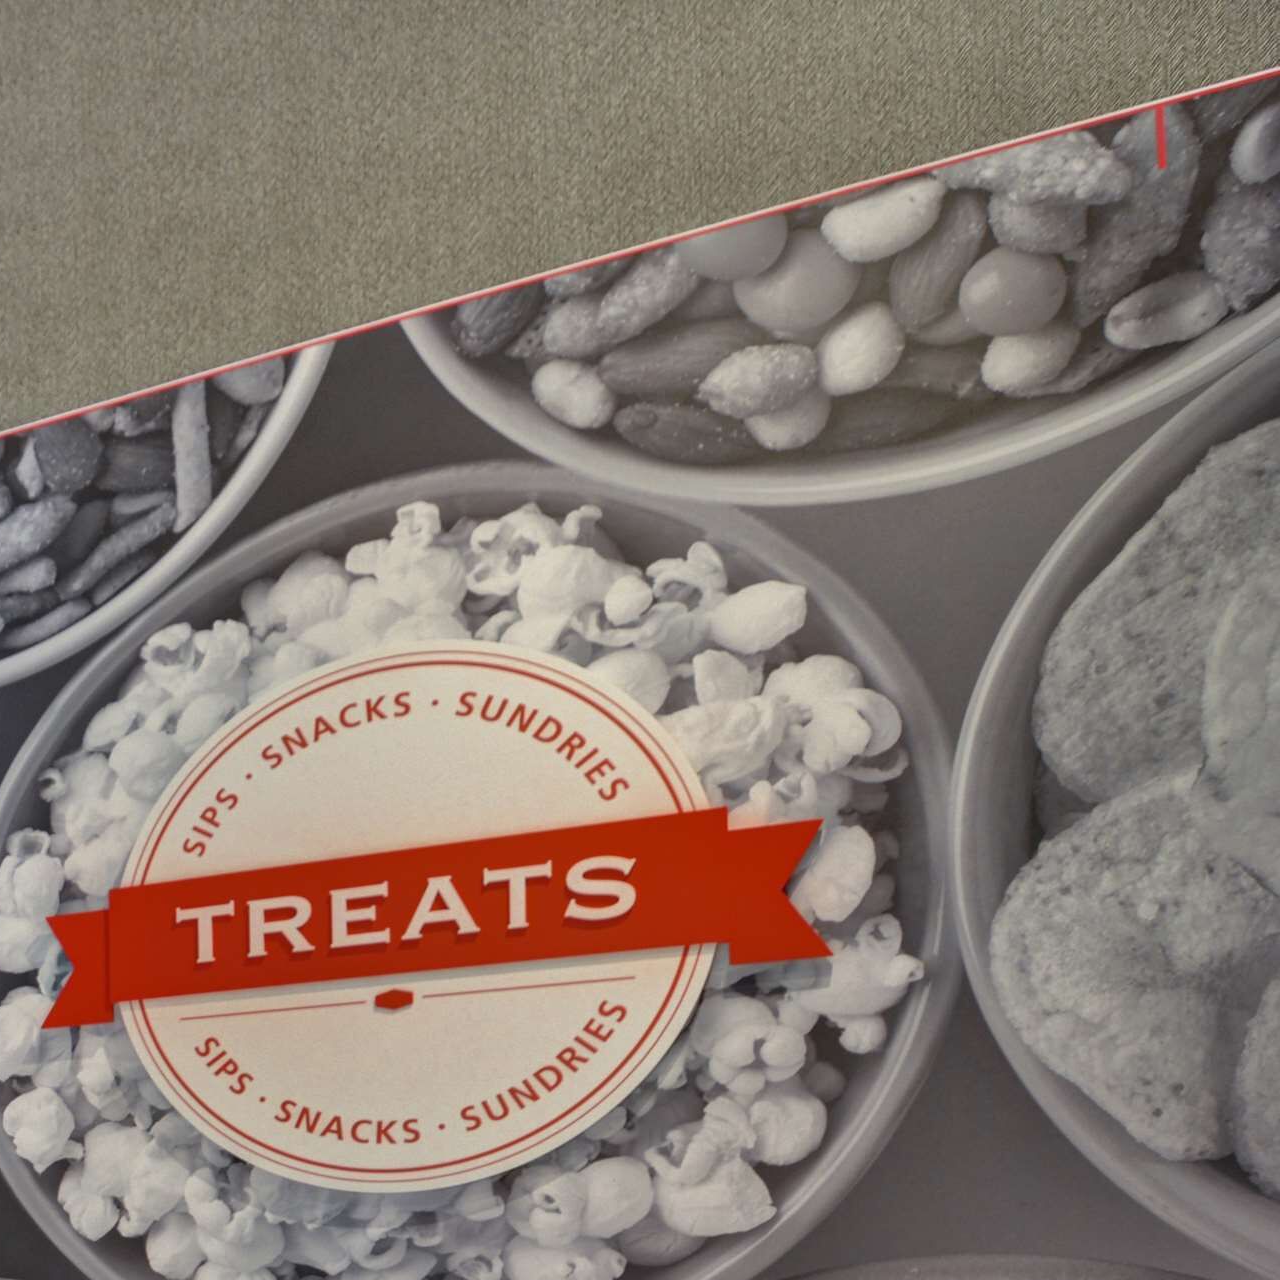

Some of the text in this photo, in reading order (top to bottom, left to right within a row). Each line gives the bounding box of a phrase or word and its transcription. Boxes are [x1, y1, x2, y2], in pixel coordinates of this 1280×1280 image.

[182, 689, 630, 860] SIPS SNACKS SUNDRIES
[174, 854, 638, 966] TREATS
[195, 998, 628, 1145] SIPS SNACKS SUNDRIES
